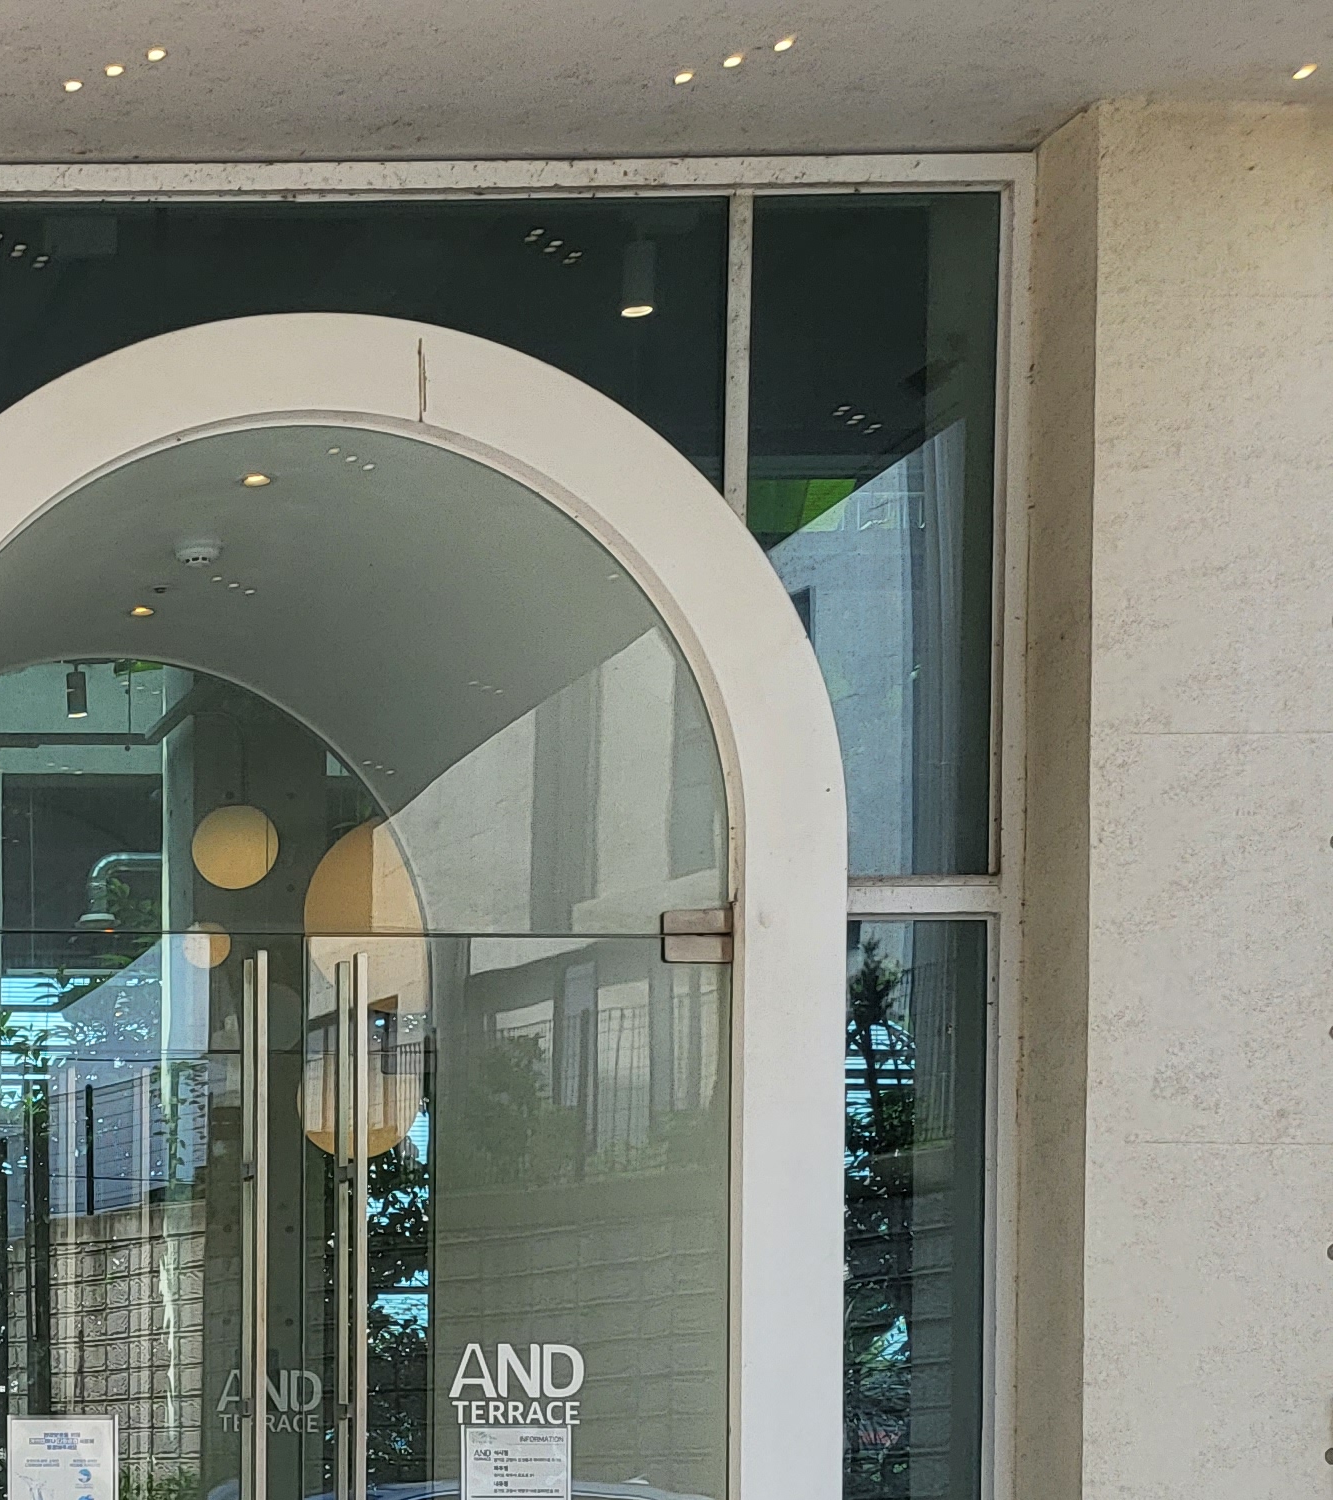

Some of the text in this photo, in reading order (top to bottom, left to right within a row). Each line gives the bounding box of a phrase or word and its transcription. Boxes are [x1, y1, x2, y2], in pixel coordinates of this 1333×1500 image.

[448, 1343, 585, 1398] AND
[451, 1400, 581, 1425] TERRACE
[473, 1449, 492, 1457] AND
